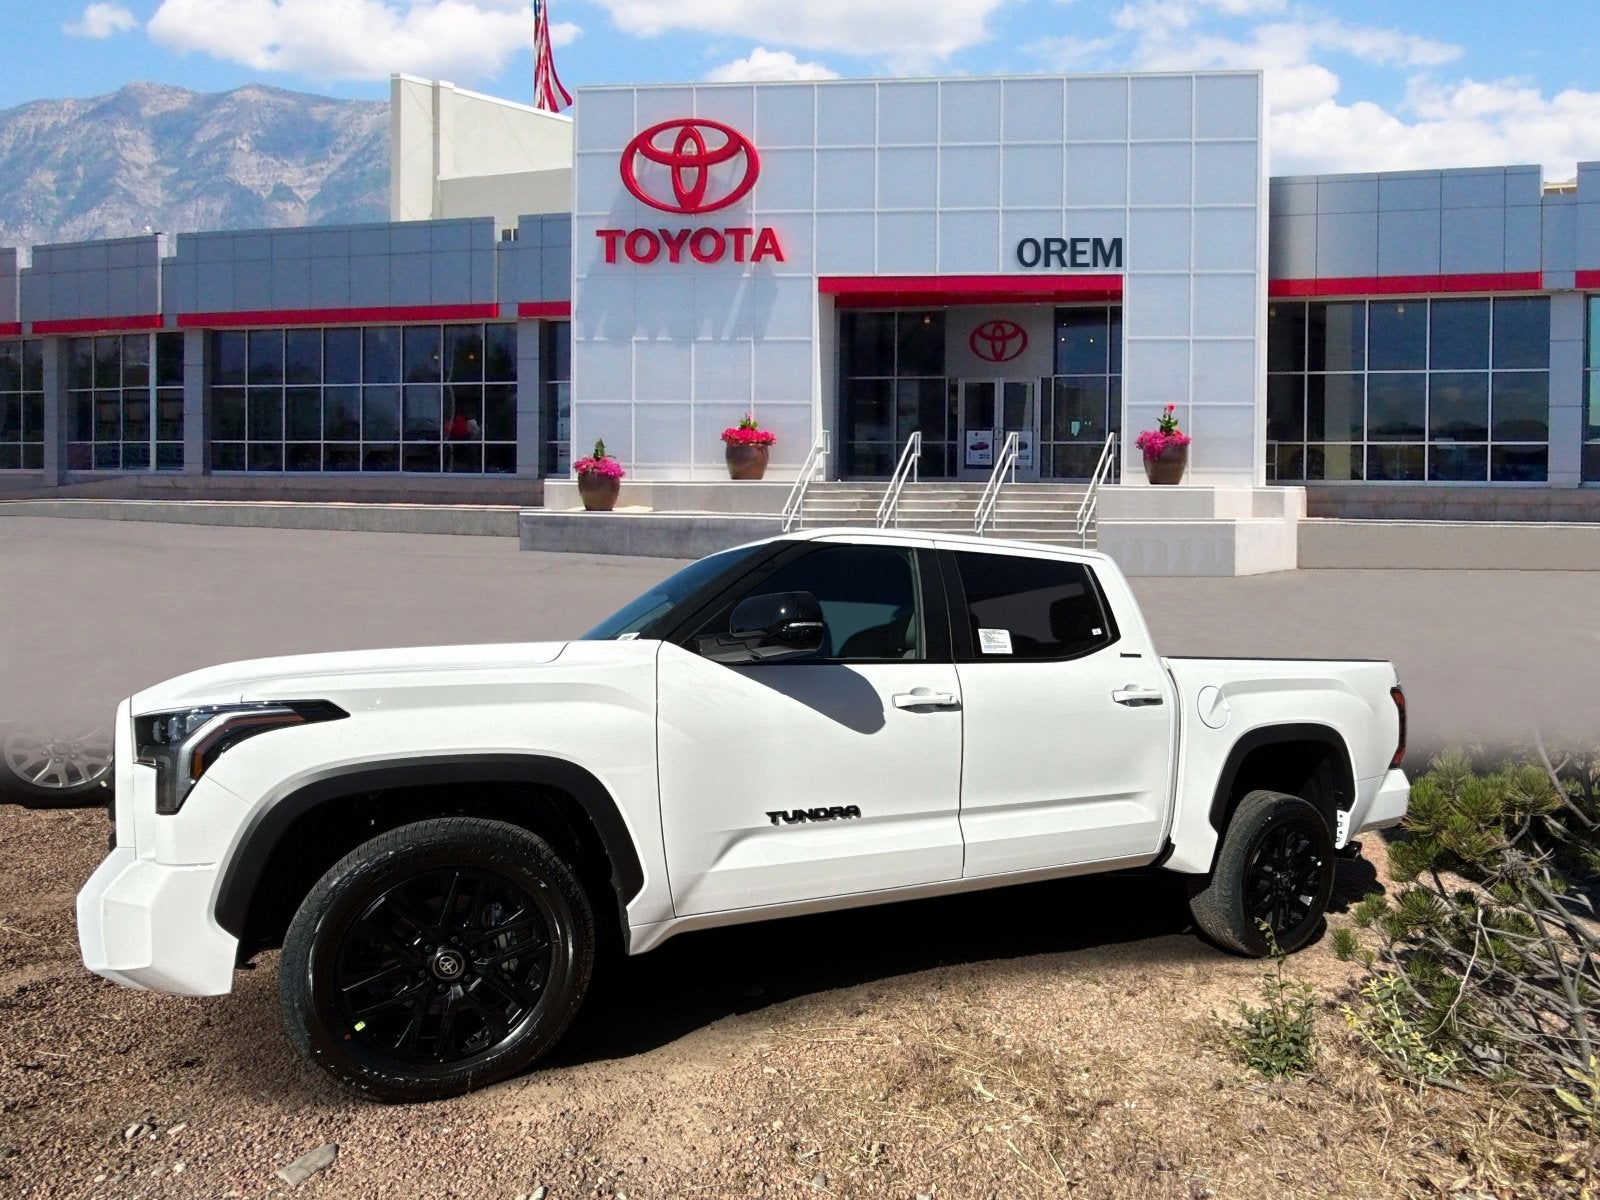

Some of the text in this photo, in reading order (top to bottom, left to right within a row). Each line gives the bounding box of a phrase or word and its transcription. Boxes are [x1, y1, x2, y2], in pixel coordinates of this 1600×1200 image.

[596, 227, 784, 264] TOYOTA
[1017, 237, 1123, 268] OREM
[766, 805, 861, 825] TUNDRA
